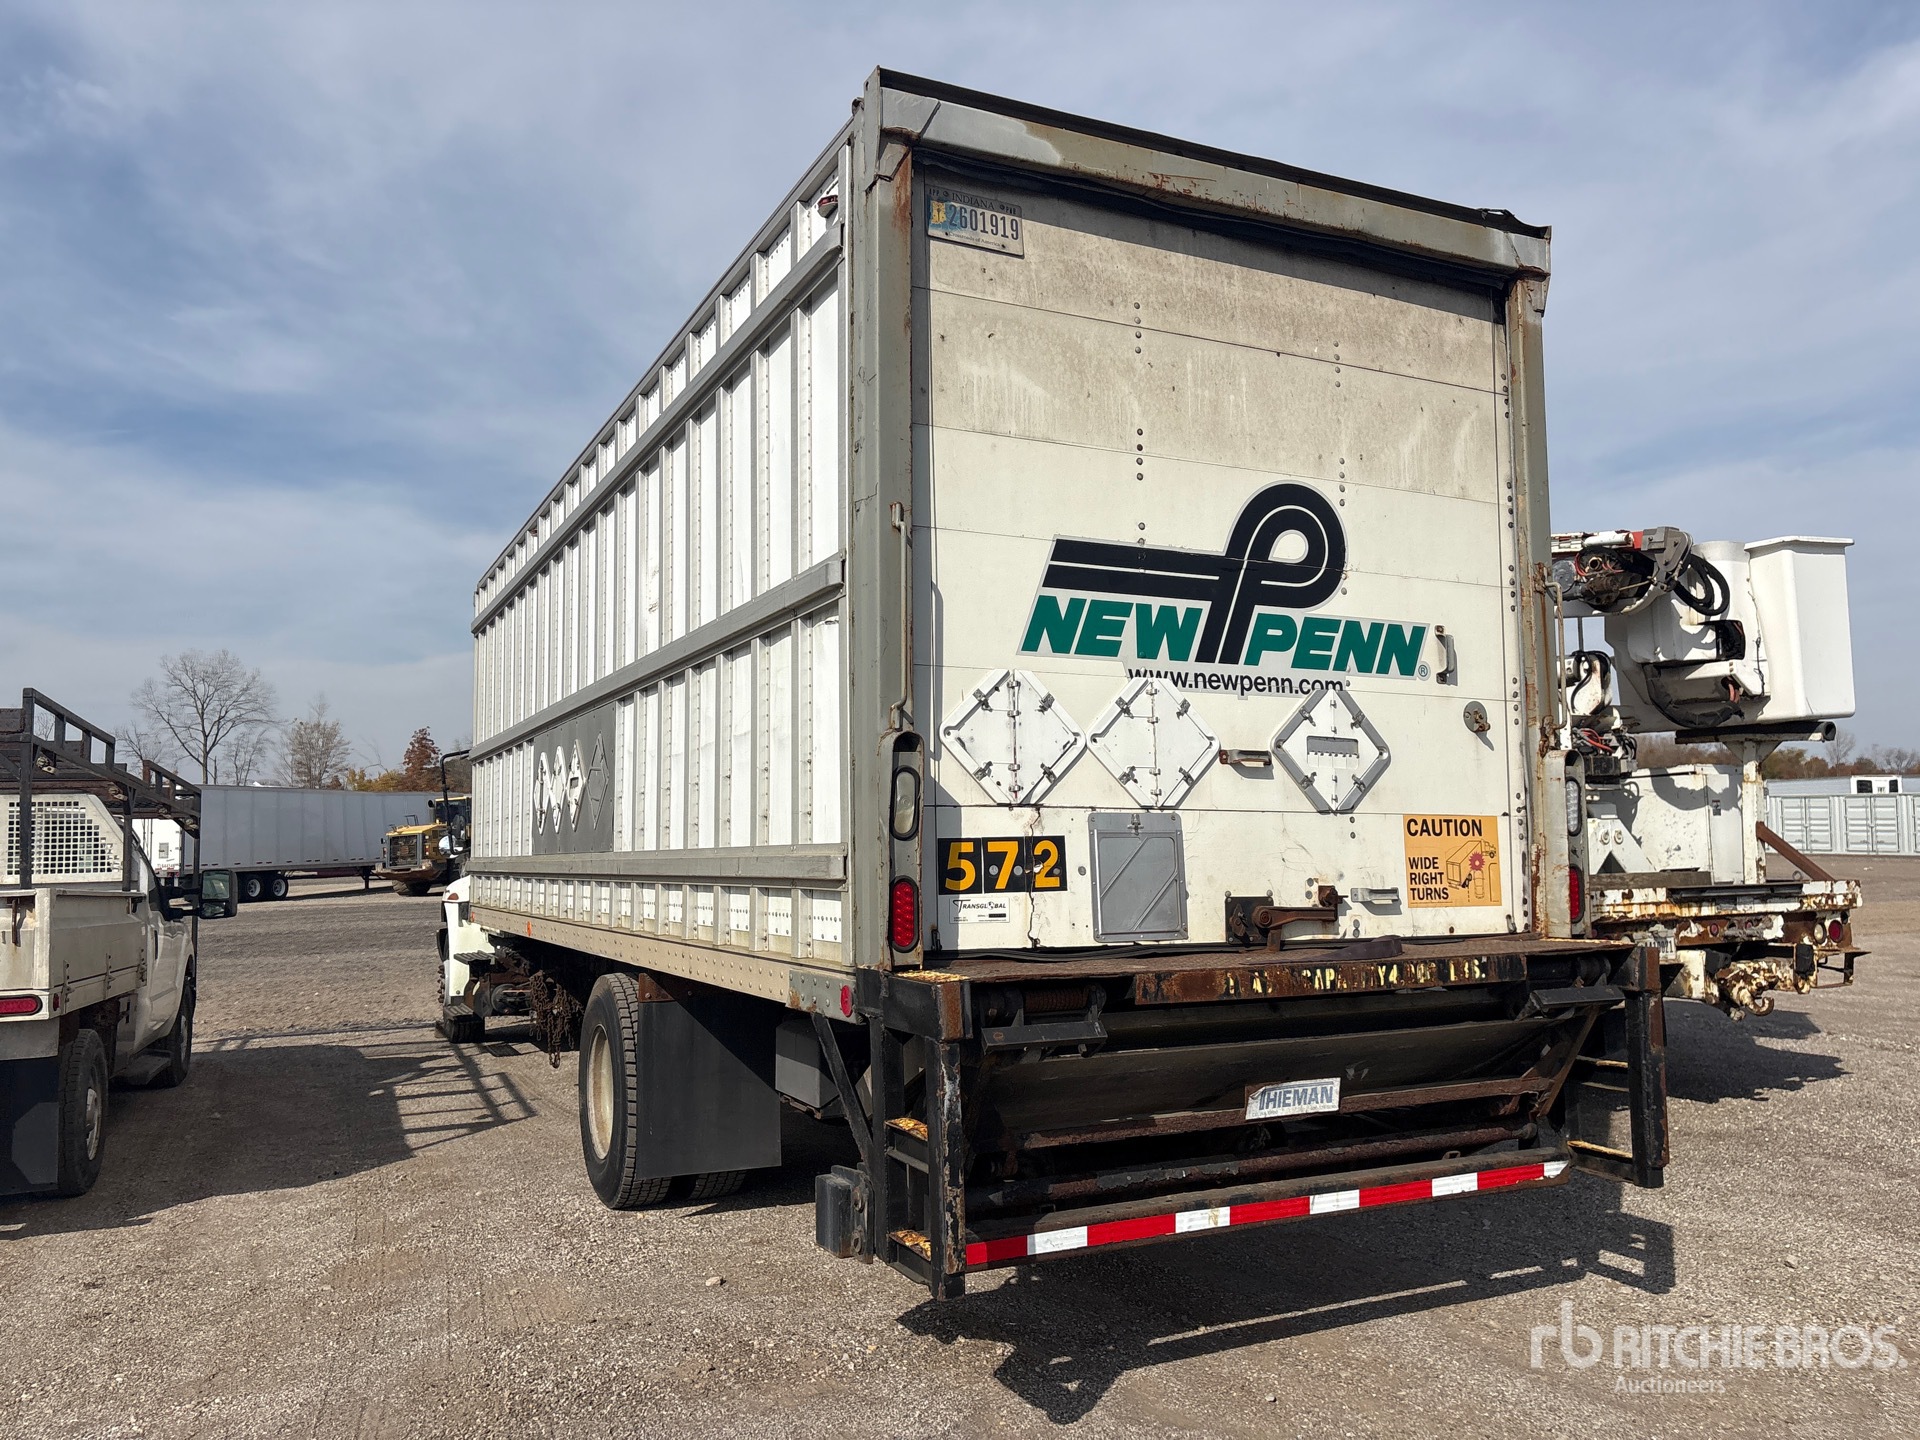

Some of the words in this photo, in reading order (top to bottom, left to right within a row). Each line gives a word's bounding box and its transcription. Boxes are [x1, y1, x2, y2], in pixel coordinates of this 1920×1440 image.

[952, 192, 995, 211] INDIANA
[948, 204, 1019, 241] 2601919
[1020, 595, 1204, 663] NEW
[1243, 612, 1427, 677] PENN
[1128, 668, 1344, 696] www.newpenn.com
[1406, 818, 1483, 837] CAUTION
[1408, 856, 1440, 870] WIDE
[1409, 872, 1444, 885] RIGHT
[1410, 887, 1449, 901] TURNS
[1259, 1081, 1334, 1110] THIEMAN
